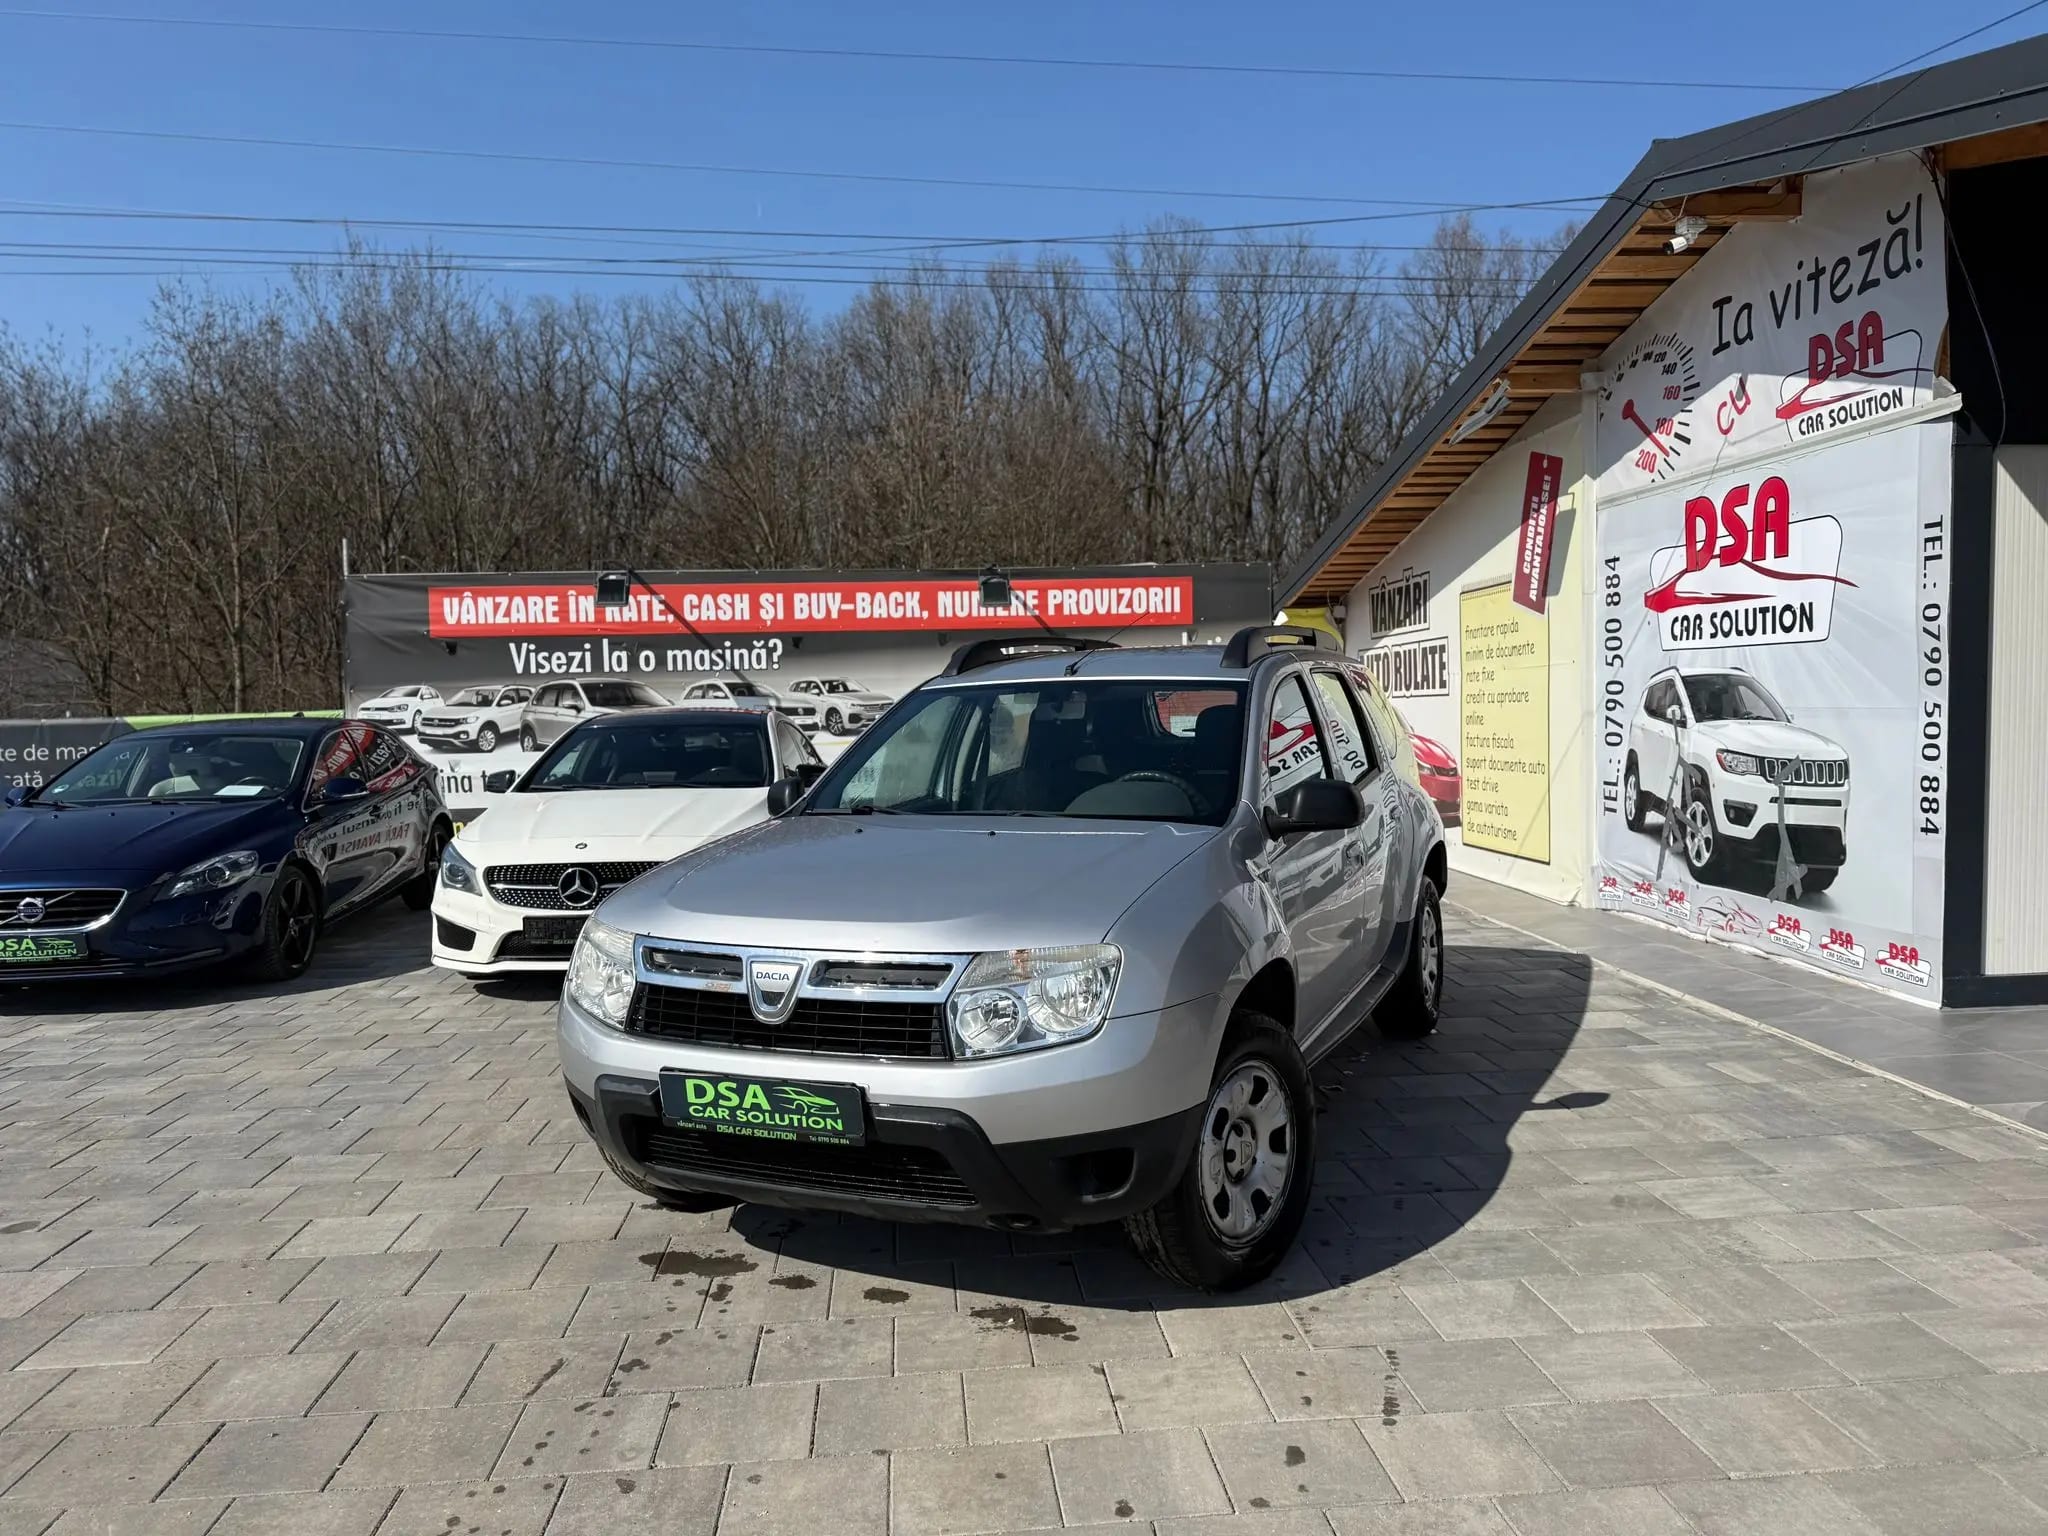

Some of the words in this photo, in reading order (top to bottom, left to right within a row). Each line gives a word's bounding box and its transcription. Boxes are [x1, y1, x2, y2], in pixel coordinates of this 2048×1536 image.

[1712, 295, 1753, 356] Ia
[1769, 192, 1924, 330] viteză!
[1808, 310, 1884, 387] DSA
[1661, 362, 1677, 376] 140
[1662, 385, 1681, 400] 160
[1798, 412, 1824, 436] CAR
[1828, 387, 1904, 428] SOLUTION
[1655, 416, 1674, 436] 180
[1635, 449, 1657, 473] 200
[1684, 475, 1790, 573] DSA
[1923, 514, 1943, 590] TEL.:
[1604, 555, 1621, 607] 884
[443, 591, 559, 625] VÂNZARE
[568, 589, 597, 623] ÎN
[684, 594, 750, 622] CASH
[759, 593, 784, 627] ȘI
[794, 590, 929, 621] BUY-BACK,
[1047, 586, 1181, 616] PROVIZORII
[1371, 574, 1428, 634] VÂNZĂRI
[1670, 614, 1703, 642] CAR
[1709, 602, 1814, 640] SOLUTION
[508, 642, 592, 675] Visezi
[602, 638, 628, 673] la
[639, 652, 656, 673] o
[666, 638, 783, 678] mașină?
[1496, 640, 1535, 659] documente
[1604, 618, 1624, 668] 500
[1922, 603, 1942, 687] 0790
[1360, 651, 1391, 693] UTO
[1394, 644, 1447, 692] RULATE
[1604, 680, 1624, 747] 0790
[1921, 701, 1941, 762] 500
[23, 744, 49, 761] de
[1603, 758, 1621, 816] TEL.:
[1919, 775, 1940, 836] 884
[1777, 914, 1800, 935] DSA
[1829, 928, 1854, 950] DSA
[17, 949, 77, 957] SOLUTION
[1888, 942, 1919, 966] DSA
[756, 971, 790, 981] DACIA
[1895, 969, 1925, 984] SOLUTION
[685, 1079, 771, 1111] DSA
[689, 1105, 731, 1120] CAR
[736, 1109, 843, 1131] SOLUTION
[716, 1124, 734, 1134] DSA
[735, 1127, 752, 1136] CAR
[753, 1129, 797, 1141] SOLUTION
